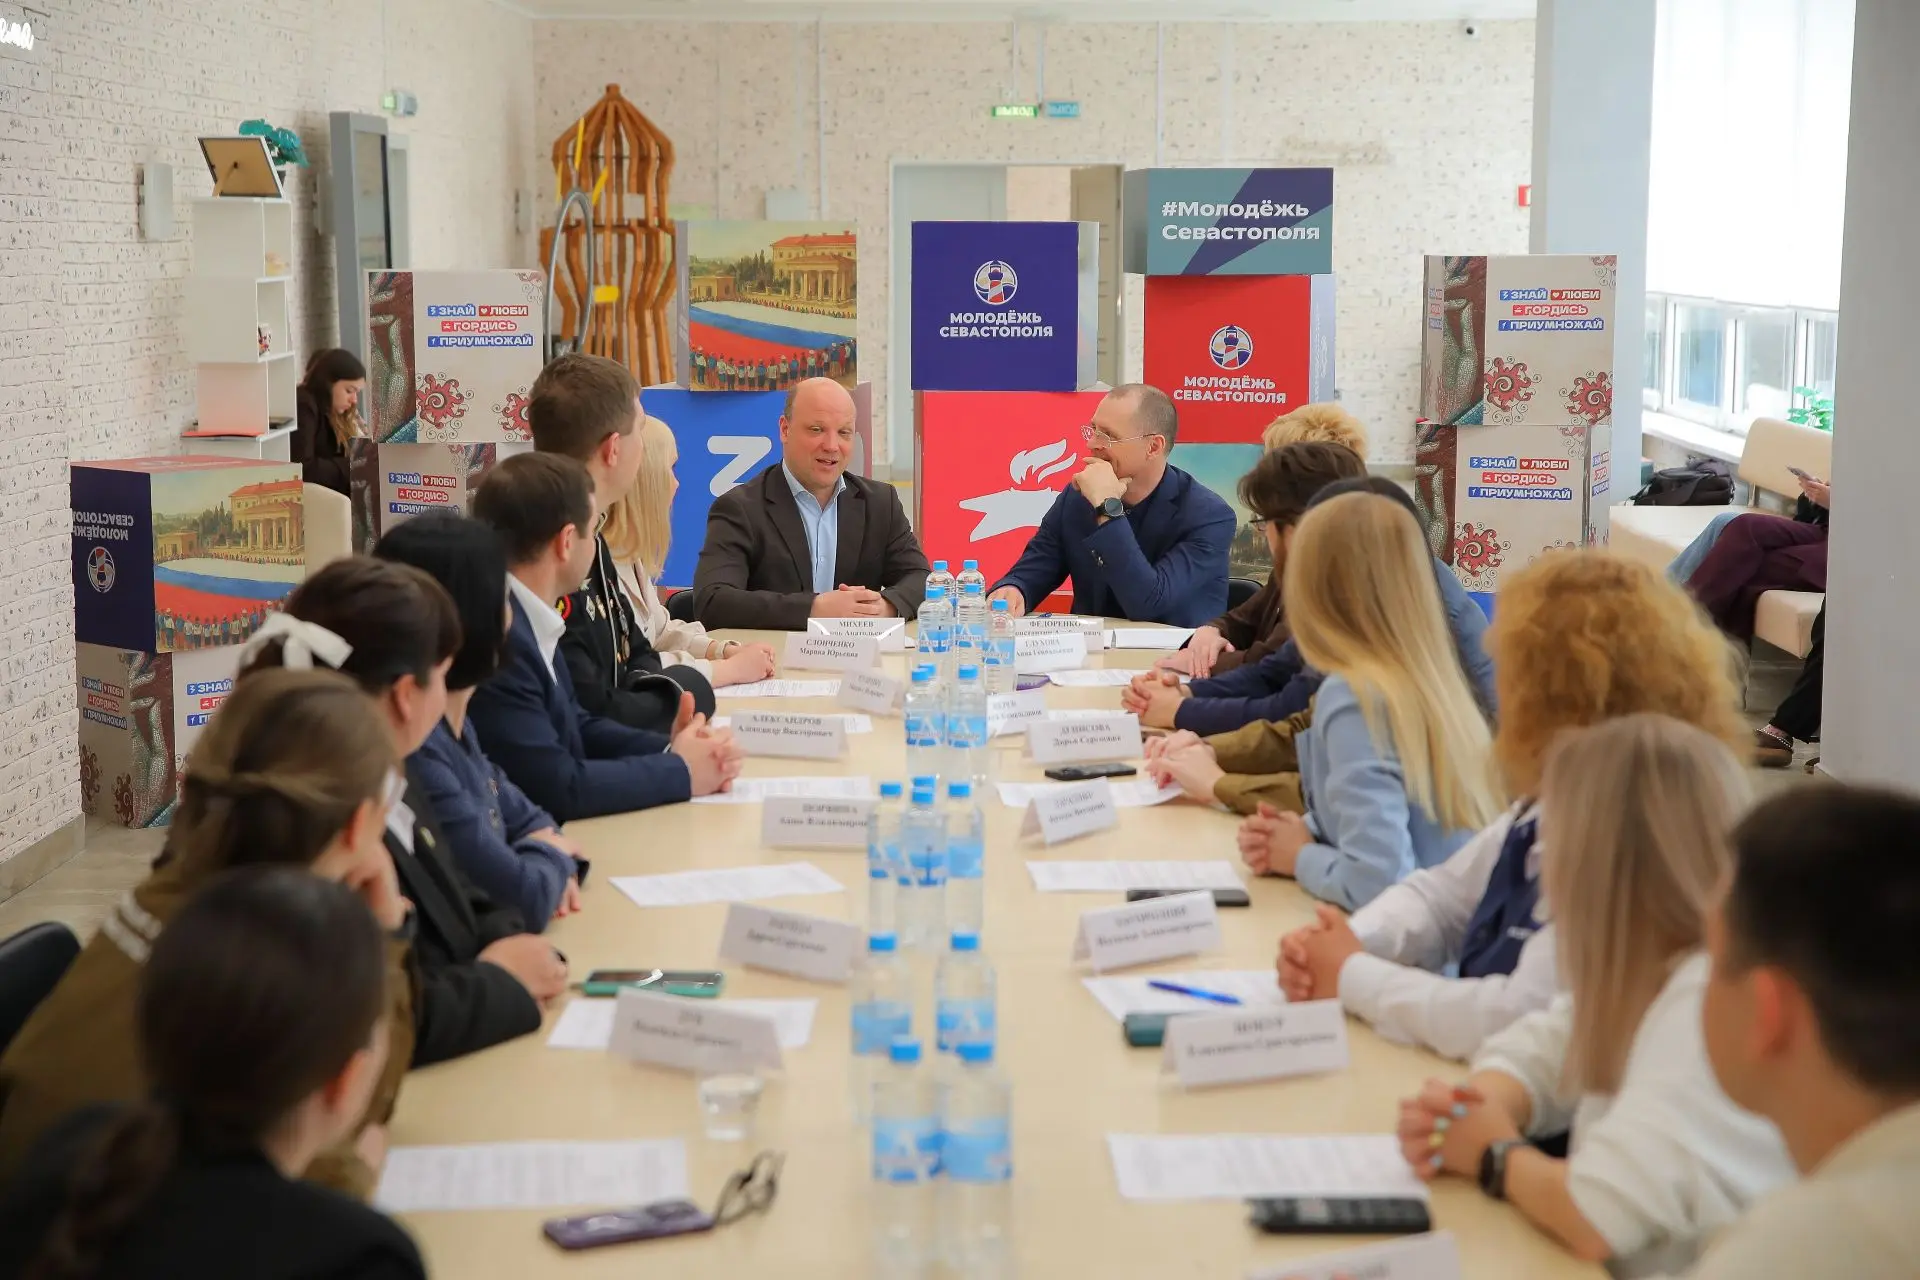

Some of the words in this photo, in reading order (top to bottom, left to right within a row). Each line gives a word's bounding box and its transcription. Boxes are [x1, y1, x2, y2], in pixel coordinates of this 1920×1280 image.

[1162, 200, 1310, 219] #Молодёжь
[1162, 224, 1320, 240] Севастополя
[1510, 288, 1548, 300] ЗНАЙ
[1561, 290, 1600, 300] ЛЮБИ
[439, 304, 475, 317] ЗНАЙ
[489, 306, 528, 316] ЛЮБИ
[950, 309, 1042, 325] МОЛОДЁЖЬ
[1524, 305, 1588, 317] ГОРДИСЬ
[453, 321, 517, 332] ГОРДИСЬ
[1510, 318, 1604, 331] ПРИУМНОЖАЙ
[939, 326, 1053, 338] СЕВАСТОПОЛЯ
[439, 334, 533, 346] ПРИУМНОЖАЙ
[1184, 375, 1276, 390] МОЛОДЁЖЬ
[1173, 389, 1287, 404] СЕВАСТОПОЛЯ
[1480, 456, 1517, 468] ЗНАЙ
[1530, 459, 1569, 469] ЛЮБИ
[396, 473, 420, 484] ЗНАЙ
[430, 477, 456, 488] ЛЮБИ
[1494, 473, 1557, 485] ГОРДИСЬ
[406, 489, 449, 502] ГОРДИСЬ
[1480, 487, 1571, 500] ПРИУМНОЖАЙ
[72, 511, 134, 527] СЕВАСТОПО
[806, 639, 855, 649] СЛОНЧЕНКО
[799, 647, 826, 657] Марина
[827, 649, 859, 659] Юрьевна
[197, 679, 233, 693] ЗНАЙ
